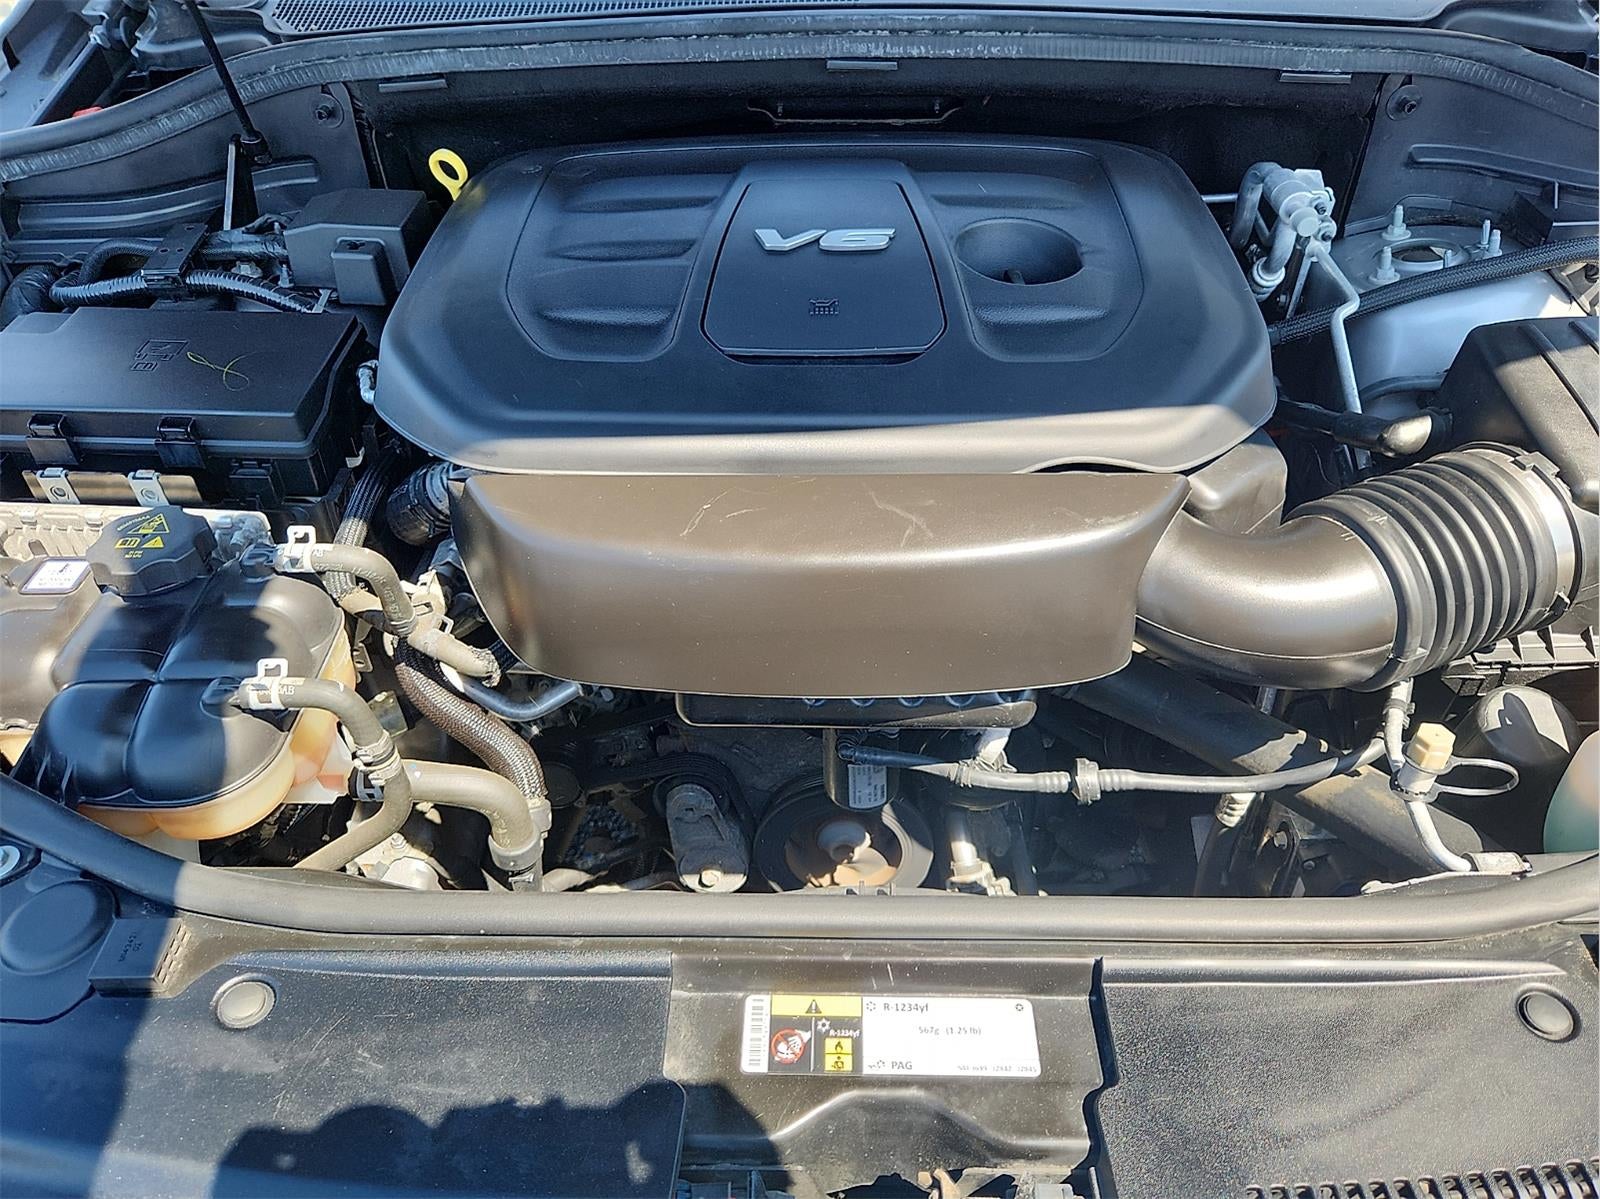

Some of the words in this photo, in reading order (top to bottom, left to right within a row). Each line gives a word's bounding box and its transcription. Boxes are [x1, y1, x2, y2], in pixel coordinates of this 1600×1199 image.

[754, 228, 896, 252] V6
[883, 1002, 929, 1013] R-1234yf
[891, 1060, 913, 1070] PAG
